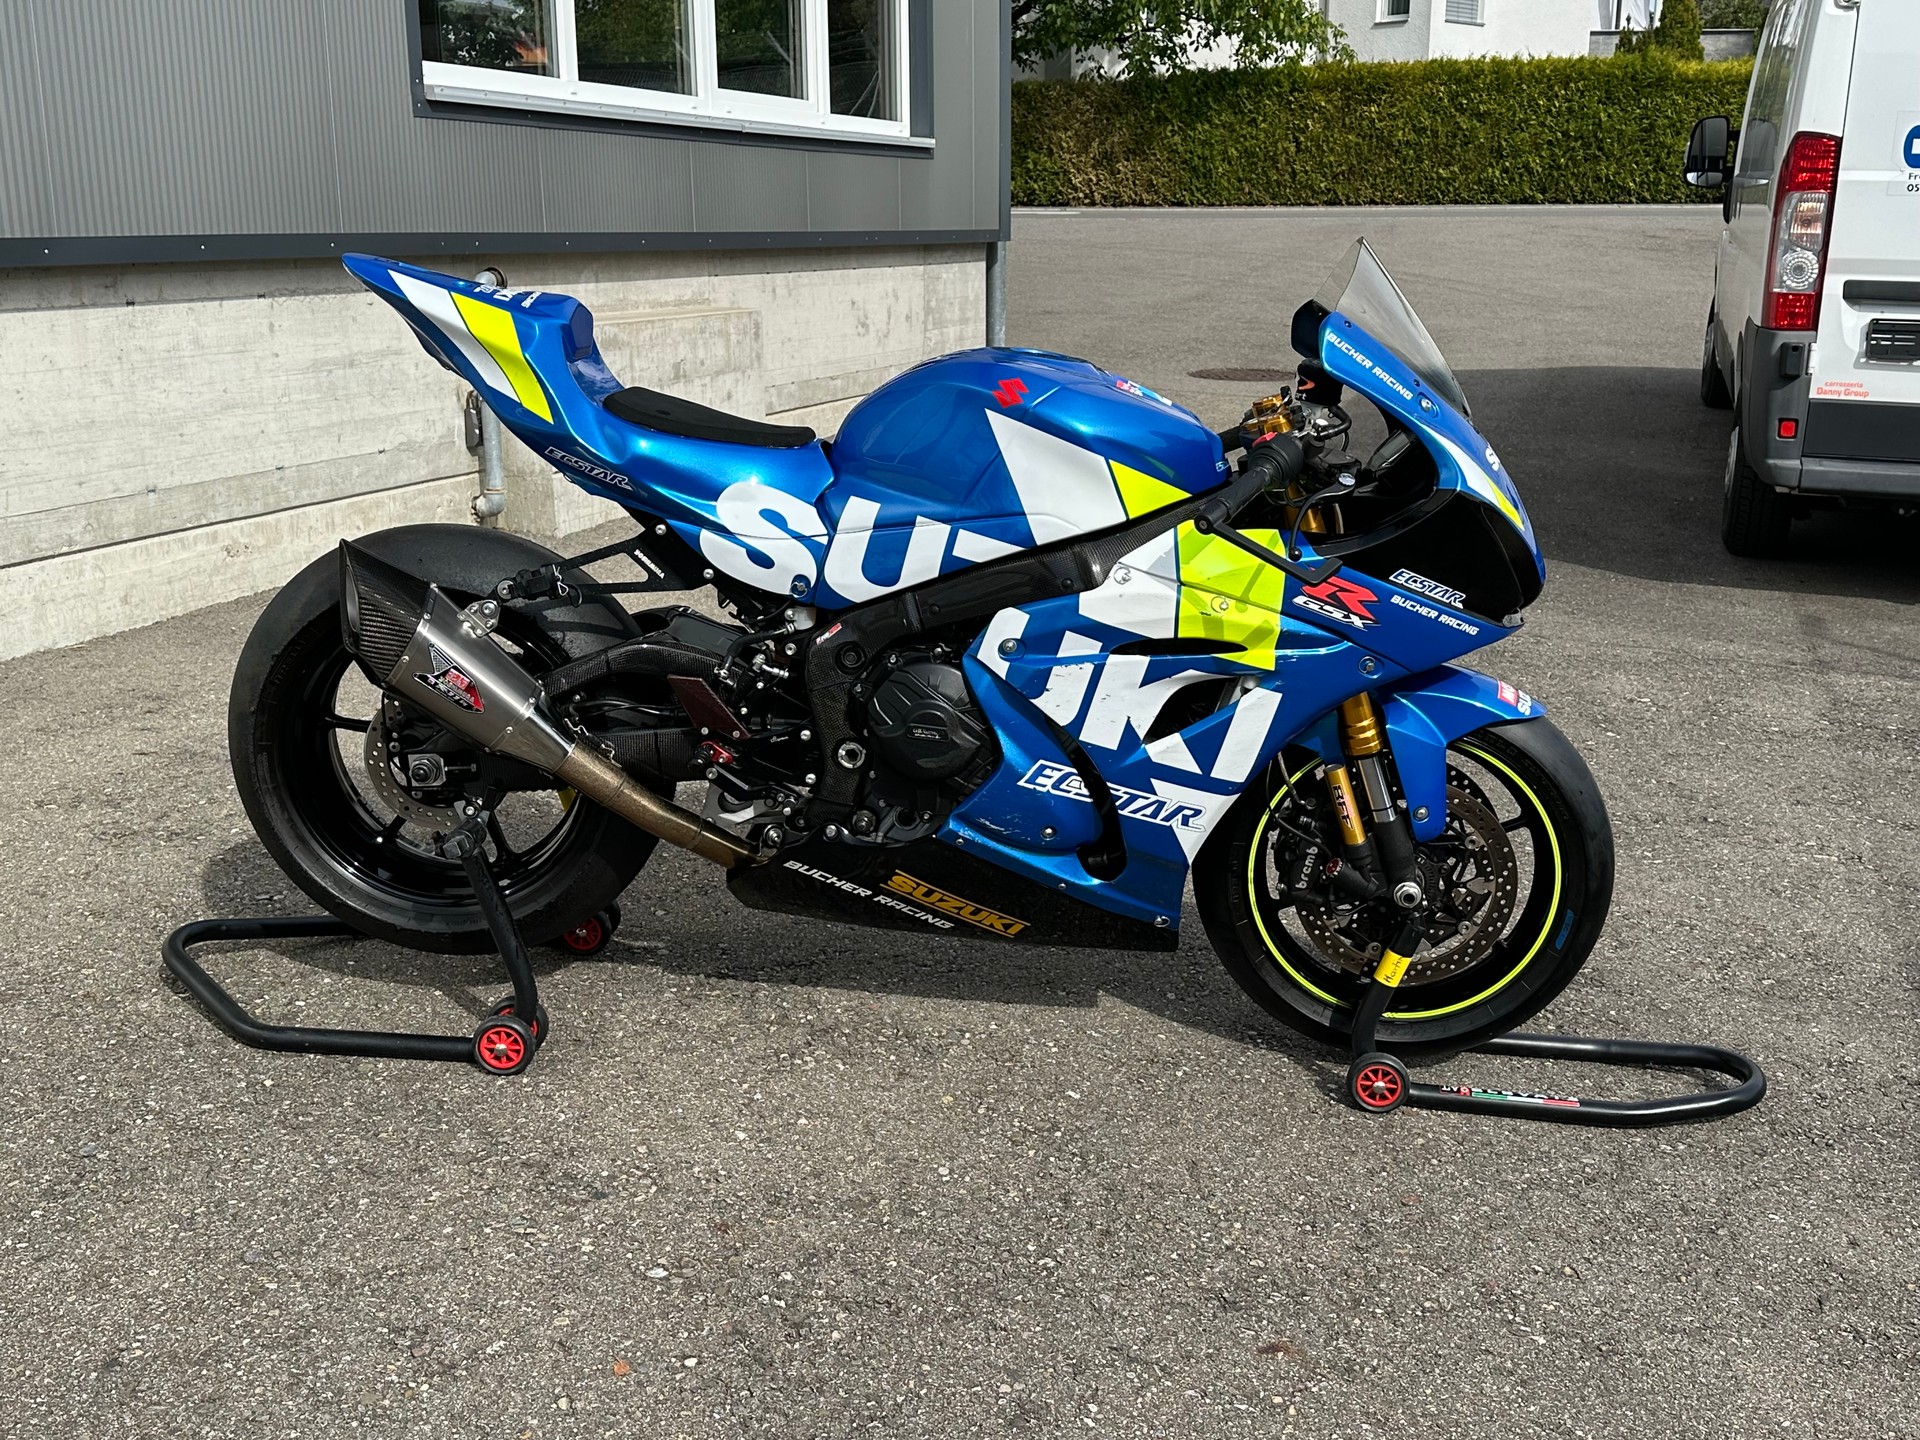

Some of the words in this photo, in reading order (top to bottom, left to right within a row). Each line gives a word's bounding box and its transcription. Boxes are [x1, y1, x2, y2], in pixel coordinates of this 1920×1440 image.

[1326, 332, 1373, 369] BUCHER
[1372, 366, 1414, 401] RACING
[1816, 387, 1842, 398] Danny
[1843, 388, 1870, 399] Group
[544, 446, 634, 492] ECSTAR
[1388, 568, 1466, 610] ECSTAR
[1292, 595, 1376, 630] GSX
[1390, 594, 1438, 620] BUCHER
[1437, 611, 1480, 636] RACING
[783, 860, 873, 898] BUCHER
[872, 894, 956, 929] RACING
[887, 875, 1026, 936] SUZUKI
